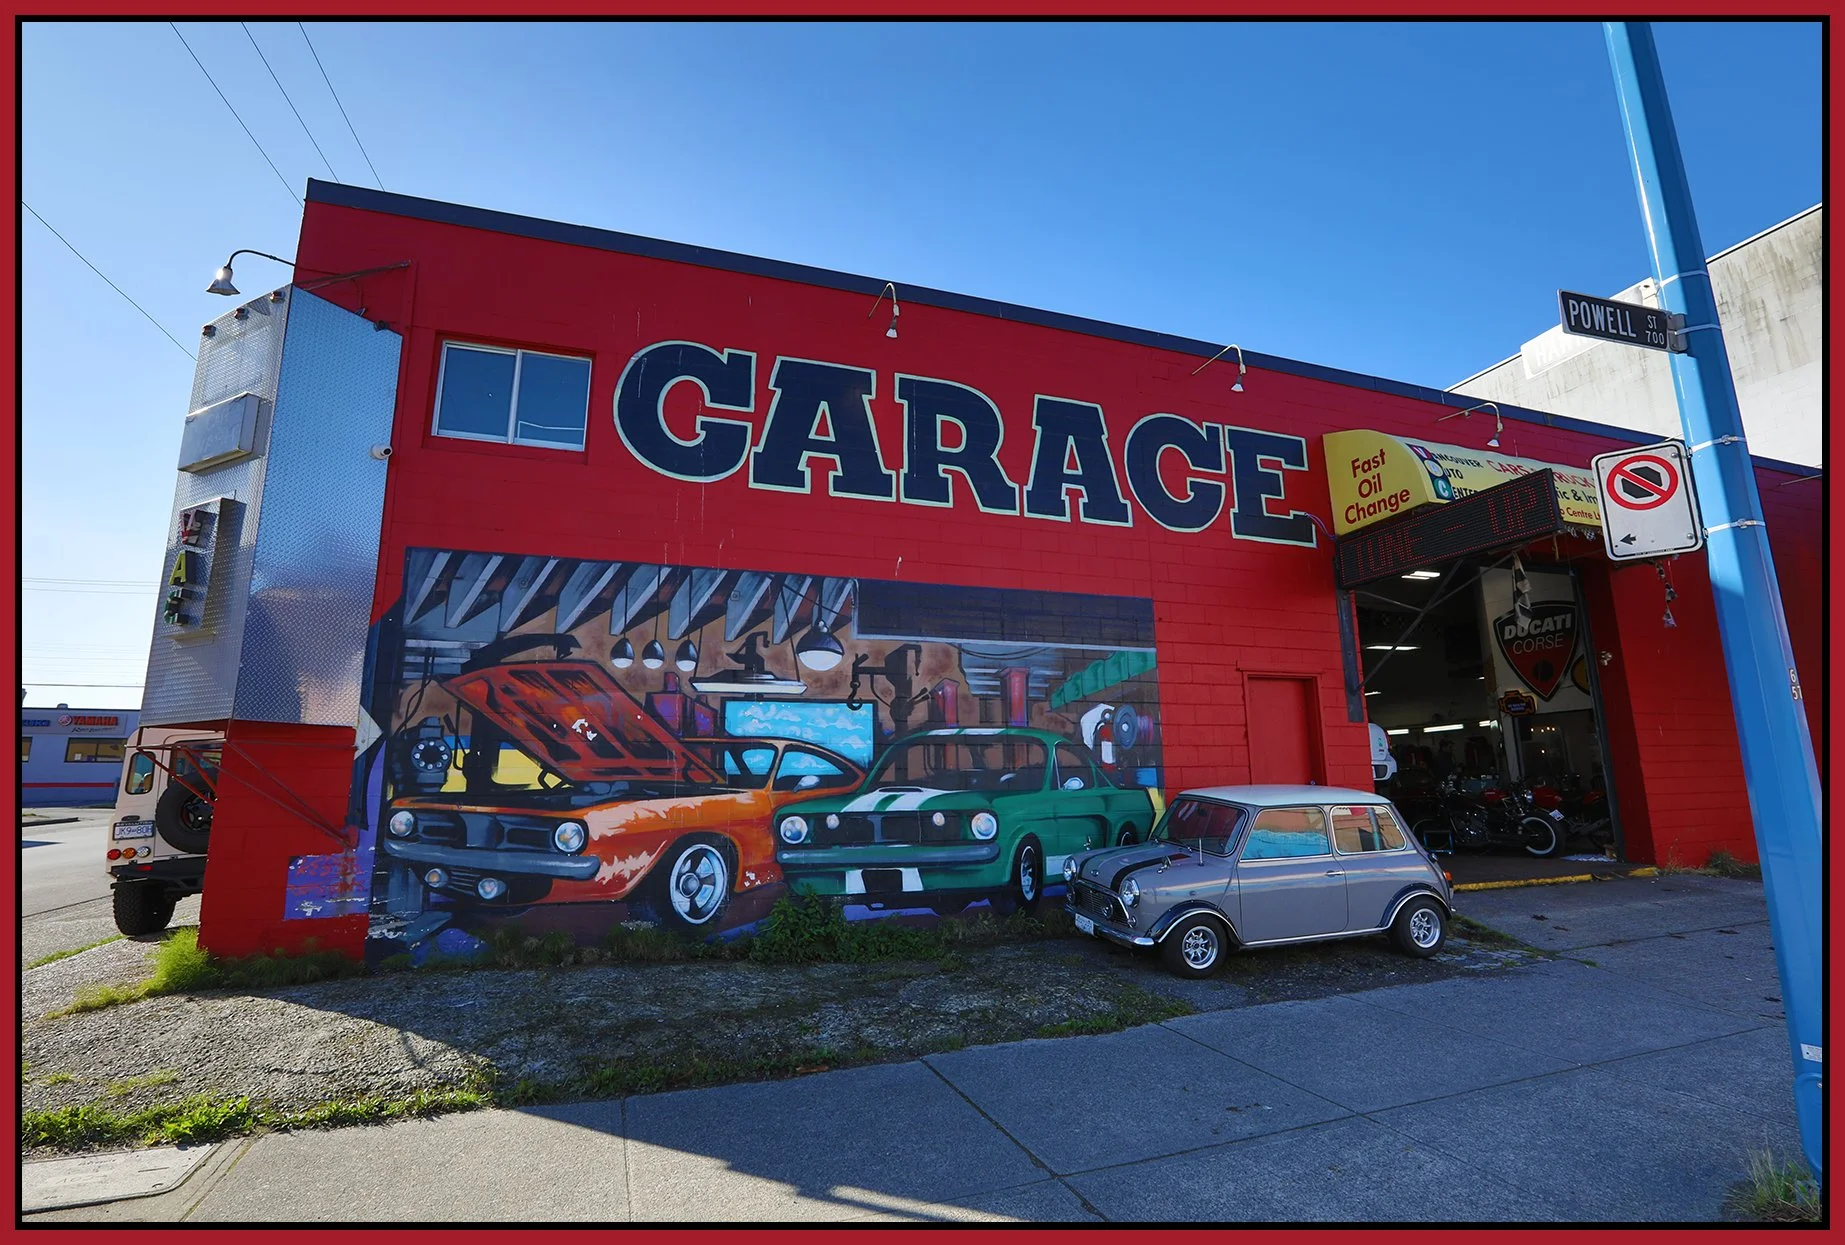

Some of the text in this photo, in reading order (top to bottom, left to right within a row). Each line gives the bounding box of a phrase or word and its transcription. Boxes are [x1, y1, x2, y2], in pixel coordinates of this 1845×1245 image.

[1569, 299, 1657, 338] POWELL ST
[1645, 330, 1665, 345] 700
[613, 341, 1317, 548] GARAGE
[1351, 448, 1385, 478] Fast
[1358, 473, 1382, 498] Oil
[1345, 489, 1410, 524] Change
[1566, 507, 1593, 519] Centre
[1353, 522, 1426, 578] TUNE
[1487, 484, 1537, 536] UP
[1504, 613, 1572, 640] DUCATI
[1513, 633, 1564, 655] CORSE
[73, 715, 118, 727] YAMAHA
